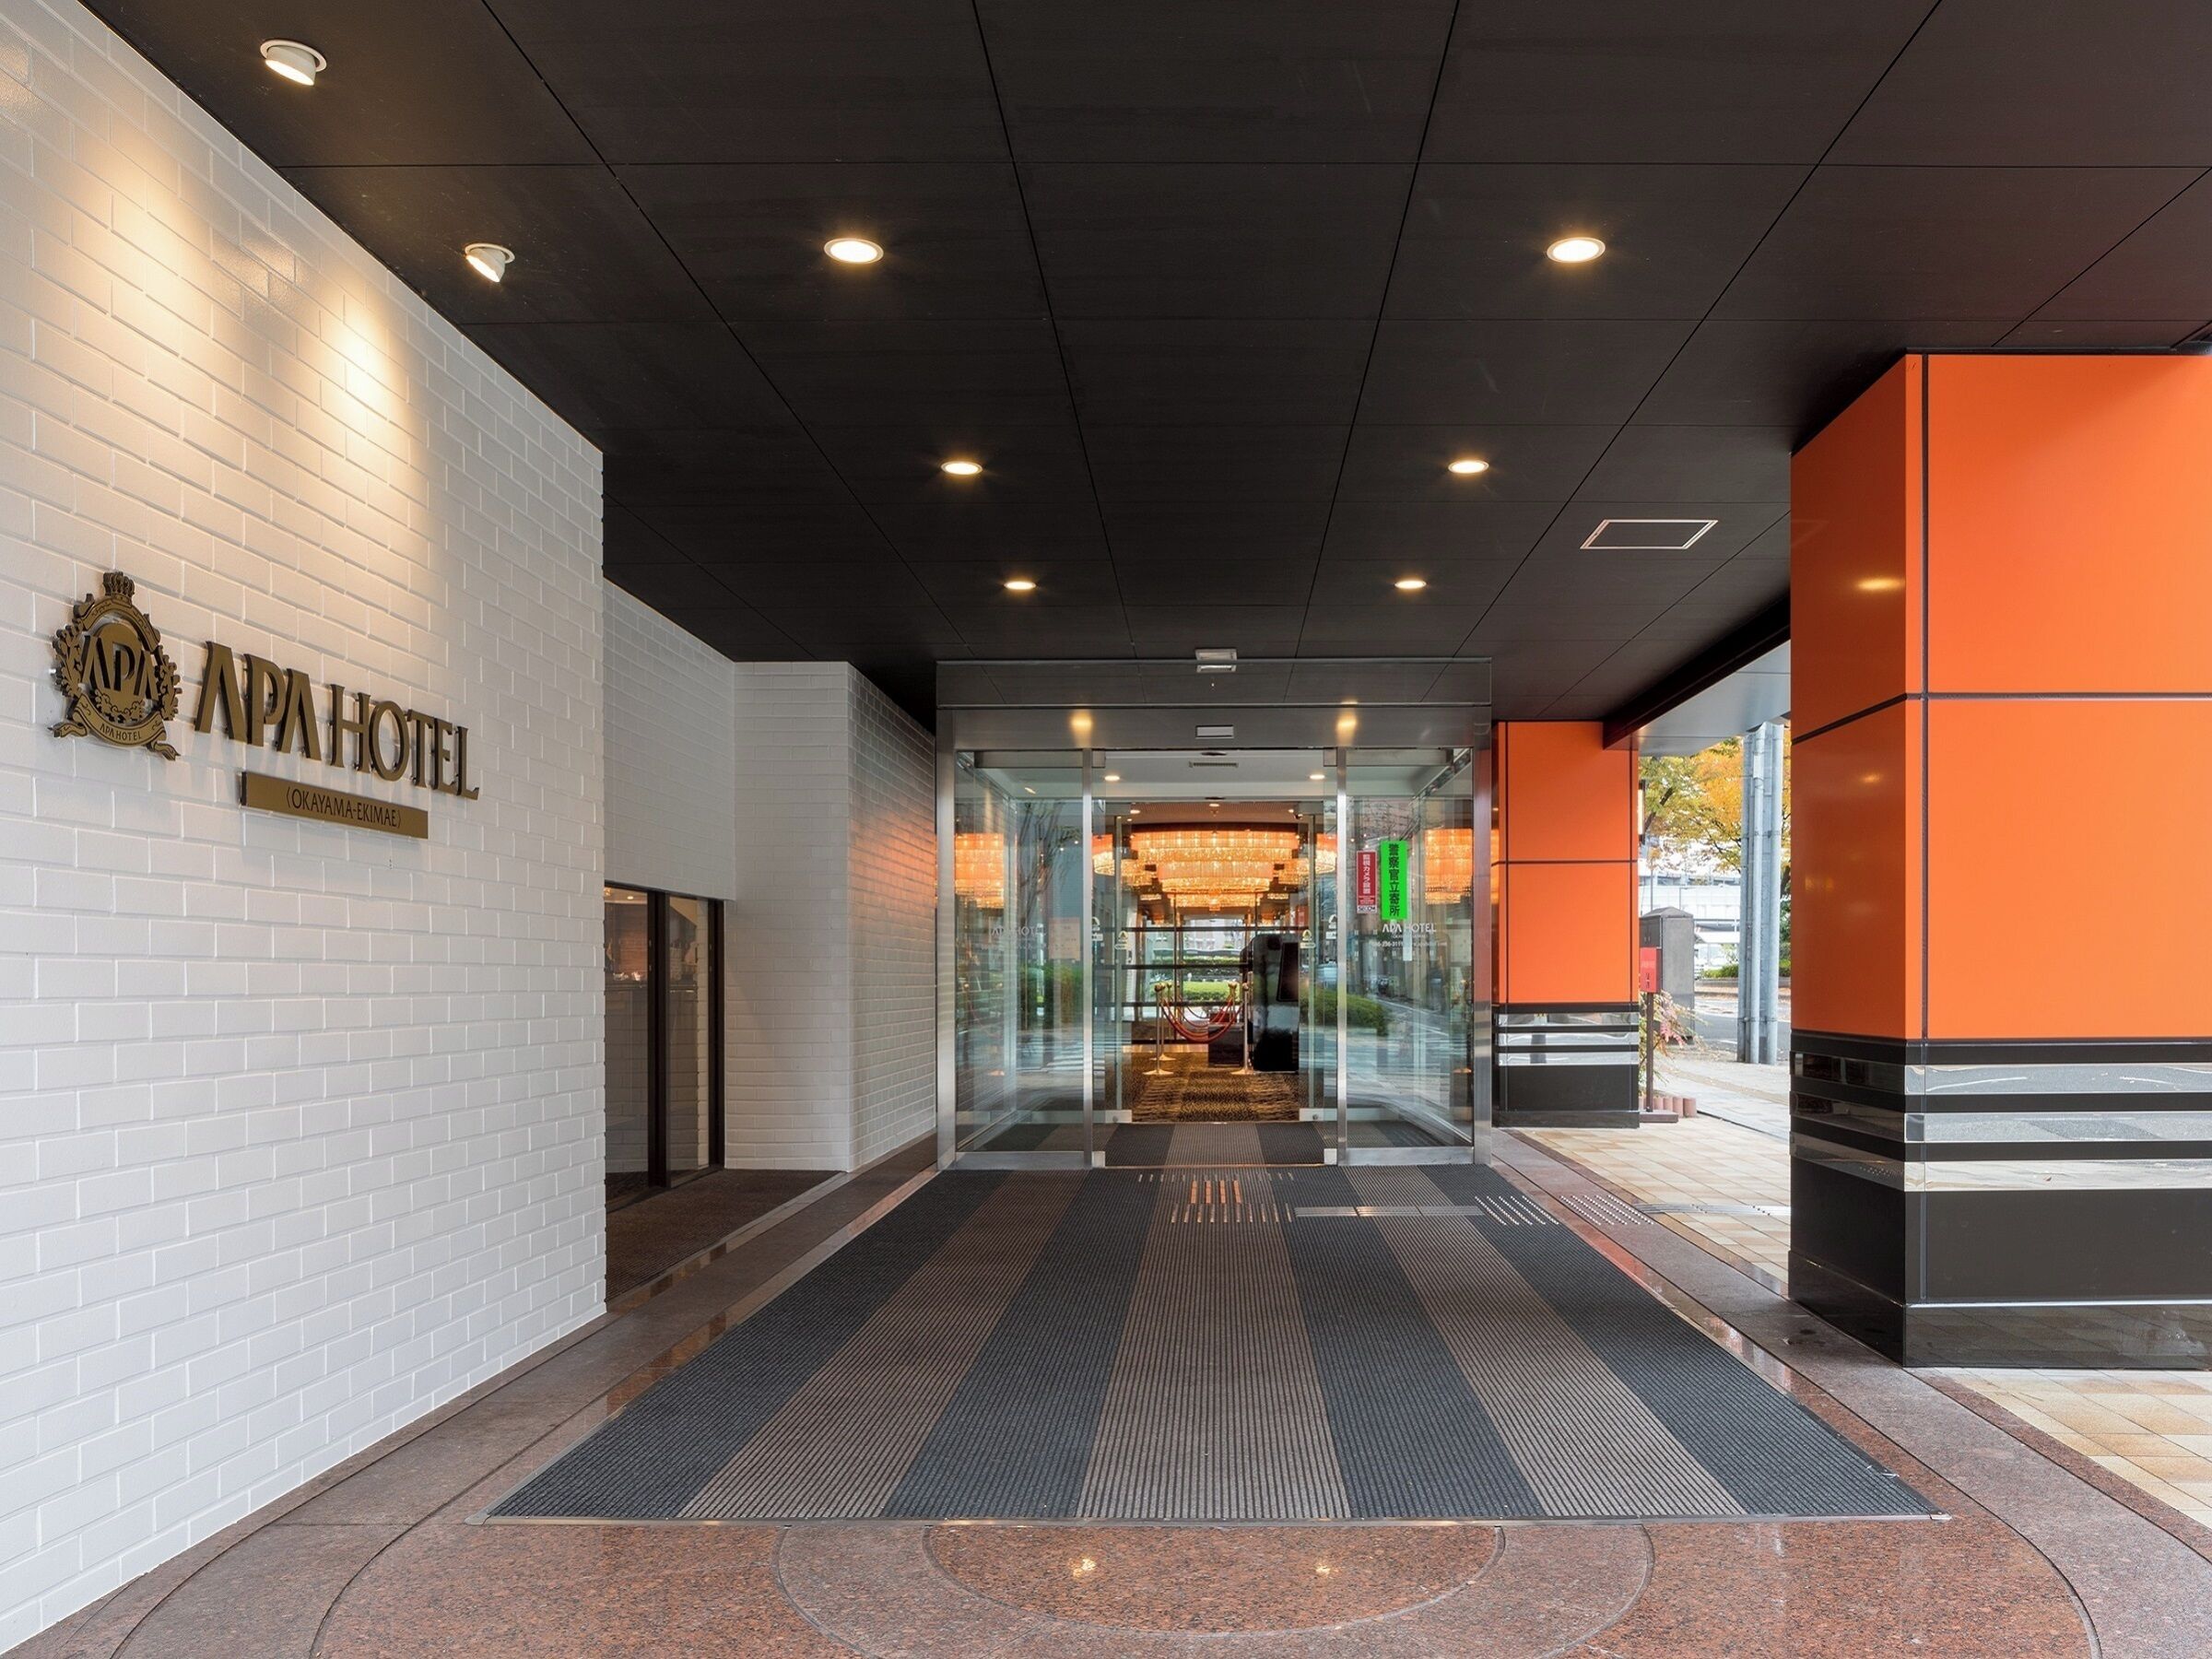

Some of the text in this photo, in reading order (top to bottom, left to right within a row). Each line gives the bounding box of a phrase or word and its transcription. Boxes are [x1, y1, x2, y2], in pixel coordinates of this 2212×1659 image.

[81, 635, 159, 700] APA
[100, 724, 142, 741] APA HOTEL
[194, 641, 479, 800] APA HOTEL
[1388, 843, 1400, 916] 警察官立寄所
